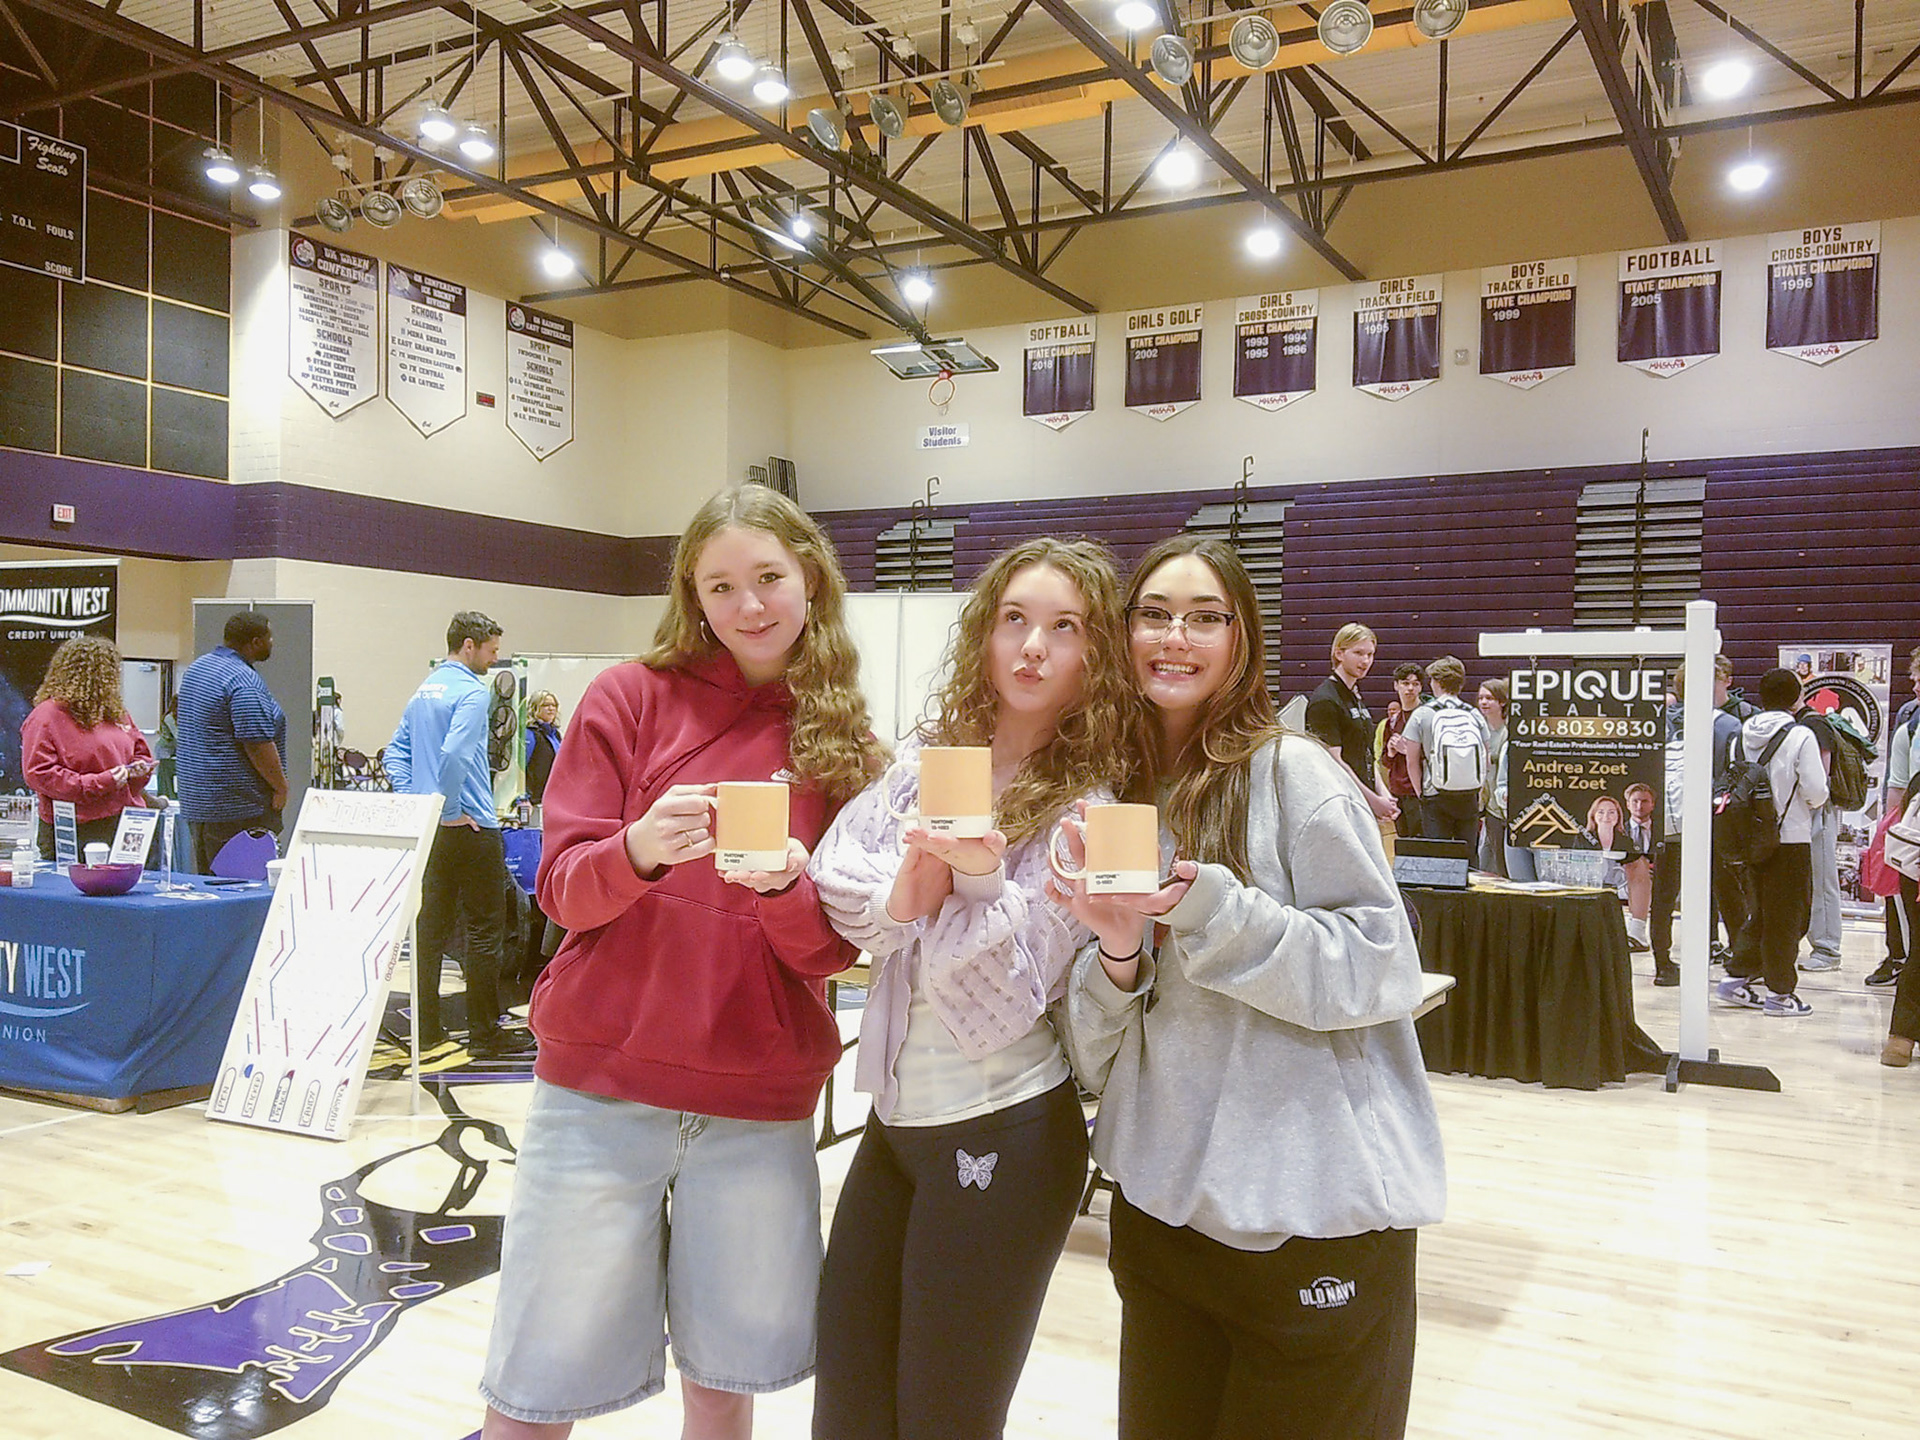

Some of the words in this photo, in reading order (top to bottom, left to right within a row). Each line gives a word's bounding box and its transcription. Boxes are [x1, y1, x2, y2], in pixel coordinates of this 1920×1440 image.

[27, 135, 77, 165] Fighting
[36, 157, 69, 176] Scots
[12, 213, 36, 230] T.O.L.
[46, 224, 74, 240] FOULS
[1803, 228, 1842, 244] BOYS
[1772, 239, 1873, 262] CROSS-COUNTRY
[1628, 247, 1714, 272] FOOTBALL
[1774, 263, 1806, 278] STATE
[1810, 256, 1873, 274] CHAMPIONS
[45, 261, 73, 276] SCORE
[317, 258, 376, 283] CONFERENCE
[1512, 262, 1545, 278] BOYS
[319, 278, 351, 294] SPORTS
[1380, 279, 1414, 294] GIRLS
[1488, 280, 1522, 294] TRACK
[1527, 278, 1533, 289] &
[1538, 274, 1569, 288] FIELD
[1625, 280, 1655, 294] STATE
[1658, 274, 1716, 290] CHAMPIONS
[1781, 278, 1813, 290] 1996
[1260, 294, 1292, 309] GIRLS
[1360, 294, 1391, 308] TRACK
[1396, 294, 1402, 304] &
[1406, 290, 1435, 303] FIELD
[1486, 296, 1515, 310] STATE
[1518, 289, 1572, 306] CHAMPIONS
[1631, 294, 1662, 307] 2005
[411, 304, 443, 321] SCHOOLS
[1129, 312, 1164, 330] GIRLS
[1170, 308, 1202, 326] GOLF
[1239, 304, 1314, 322] CROSS-COUNTRY
[1360, 311, 1384, 324] STATE
[1388, 305, 1437, 320] CHAMPIONS
[1492, 309, 1520, 321] 1999
[412, 320, 442, 334] CALEDONIA
[1030, 323, 1090, 340] SOFTBALL
[1240, 324, 1264, 336] STATE
[1266, 319, 1313, 334] CHAMPIONS
[1365, 323, 1390, 334] 1995
[316, 328, 352, 346] SCHOOLS
[398, 338, 412, 348] EAST
[1130, 337, 1154, 349] STATE
[1155, 332, 1198, 346] CHAMPIONS
[1245, 336, 1268, 348] 1993
[1283, 333, 1308, 344] 1994
[319, 342, 350, 356] CALEDONIA
[530, 340, 550, 353] SPORT
[1028, 349, 1050, 360] STATE
[1051, 344, 1091, 358] CHAMPIONS
[1135, 349, 1158, 360] 2002
[1245, 348, 1268, 359] 1995
[1282, 344, 1307, 356] 1996
[334, 362, 356, 374] CENTER
[526, 361, 554, 376] SCHOOLS
[1032, 360, 1053, 370] 2018
[928, 426, 956, 436] Visitor
[923, 437, 962, 447] Students
[58, 507, 72, 518] EXIT
[71, 586, 110, 616] WEST
[8, 630, 46, 640] CREDIT
[50, 630, 84, 639] UNION
[1511, 670, 1664, 700] EPIQUE
[1511, 702, 1664, 718] REALTY
[1517, 720, 1656, 737] 616.803.9830
[1522, 760, 1584, 774] Andrea
[1588, 760, 1628, 776] Zoet
[1526, 774, 1563, 788] Josh
[1568, 776, 1607, 790] Zoet
[24, 944, 86, 998] WEST
[218, 1086, 229, 1108] PEN
[244, 1078, 260, 1114] STICKER
[304, 1090, 316, 1124] CANDY
[1299, 1288, 1326, 1306] OLD
[1326, 1280, 1356, 1303] NAVY
